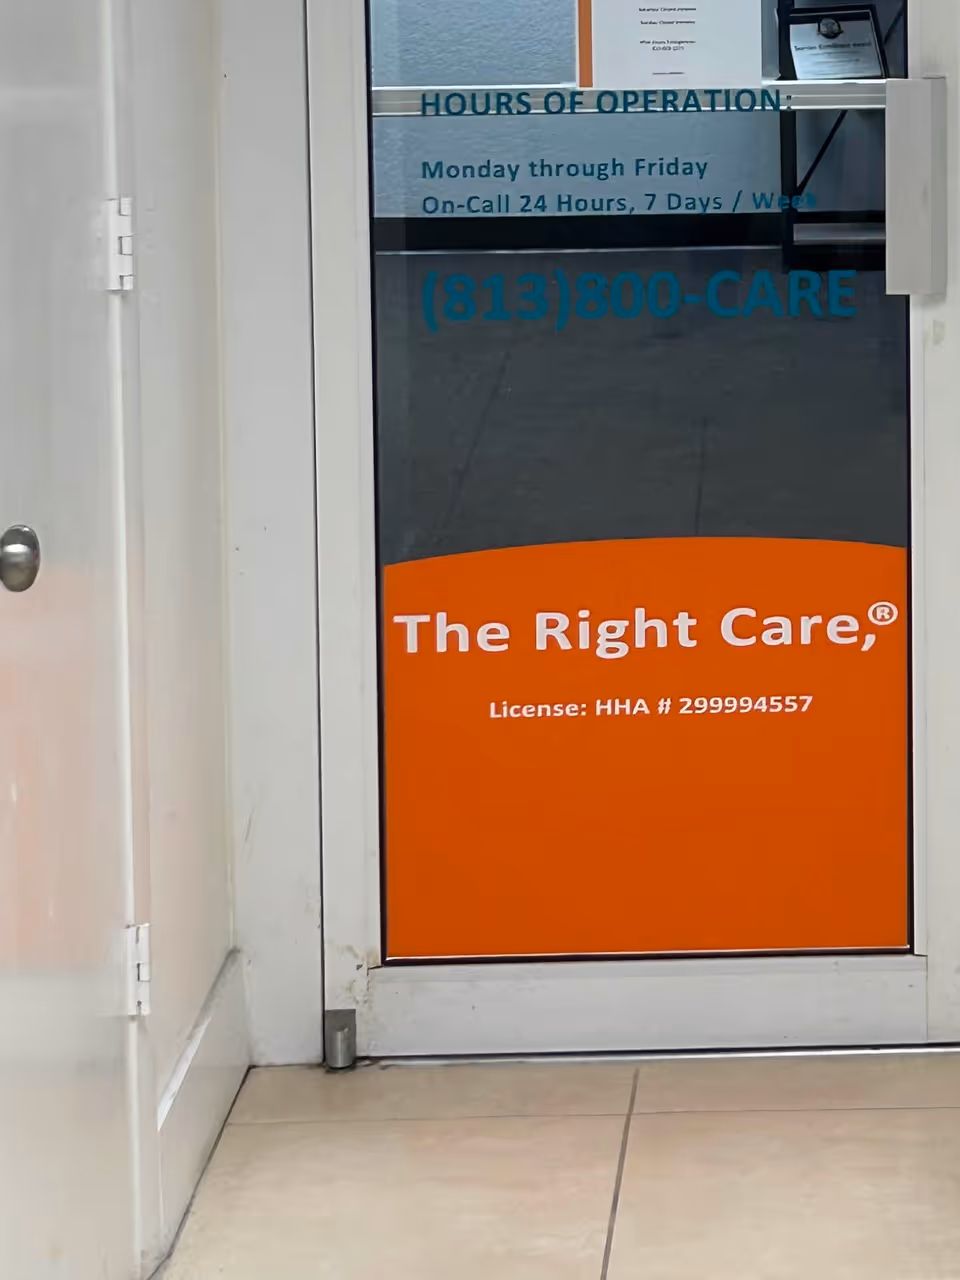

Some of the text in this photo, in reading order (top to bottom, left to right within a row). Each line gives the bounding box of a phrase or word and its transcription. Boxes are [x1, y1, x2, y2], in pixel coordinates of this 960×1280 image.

[420, 88, 798, 116] HOURS OF OPERATION:
[421, 157, 709, 182] Monday through Friday
[422, 190, 817, 214] On-Call 24 Hours, 7 Days / Week
[421, 268, 858, 333] (813)800-CARE
[393, 611, 510, 654] The
[535, 607, 698, 659] Right
[489, 694, 814, 719] License: HHA # 299994557
